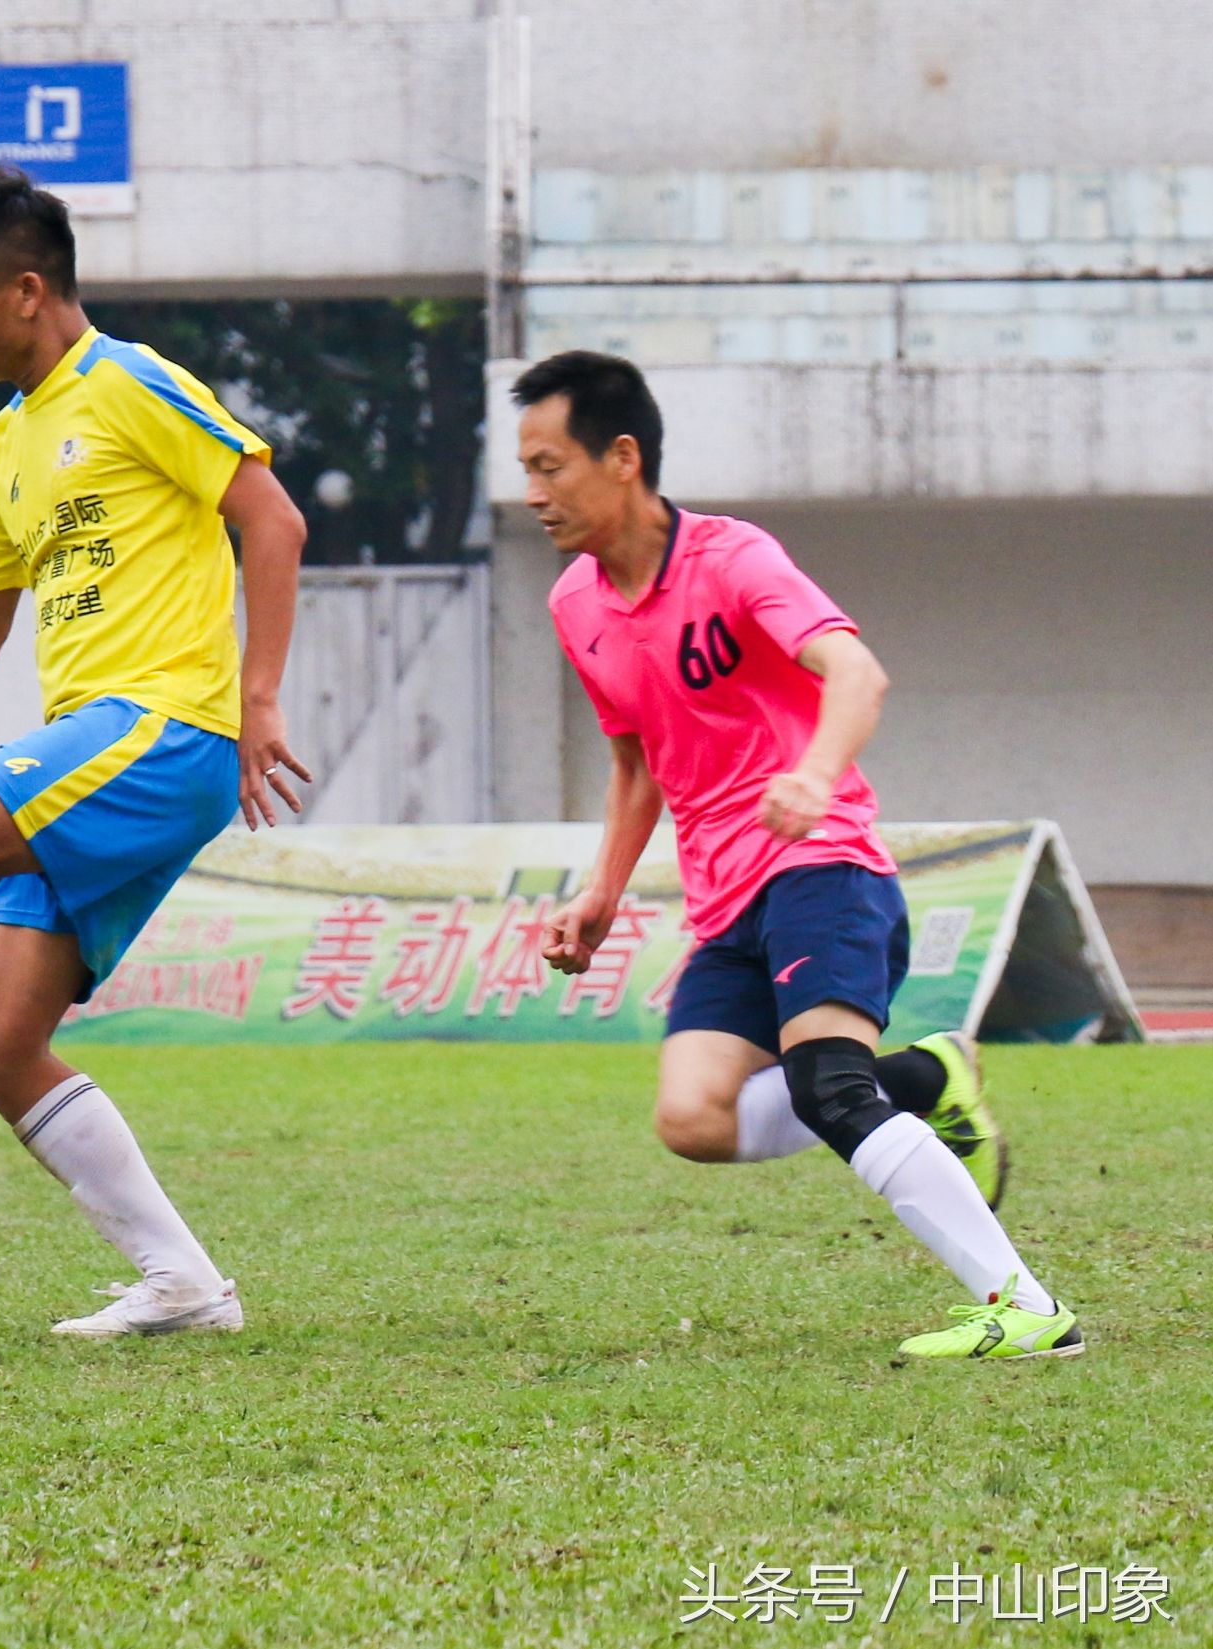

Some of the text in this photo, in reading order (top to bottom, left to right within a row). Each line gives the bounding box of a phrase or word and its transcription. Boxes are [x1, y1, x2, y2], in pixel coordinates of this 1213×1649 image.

[678, 612, 742, 690] 60
[284, 893, 691, 1021] 美动体育
